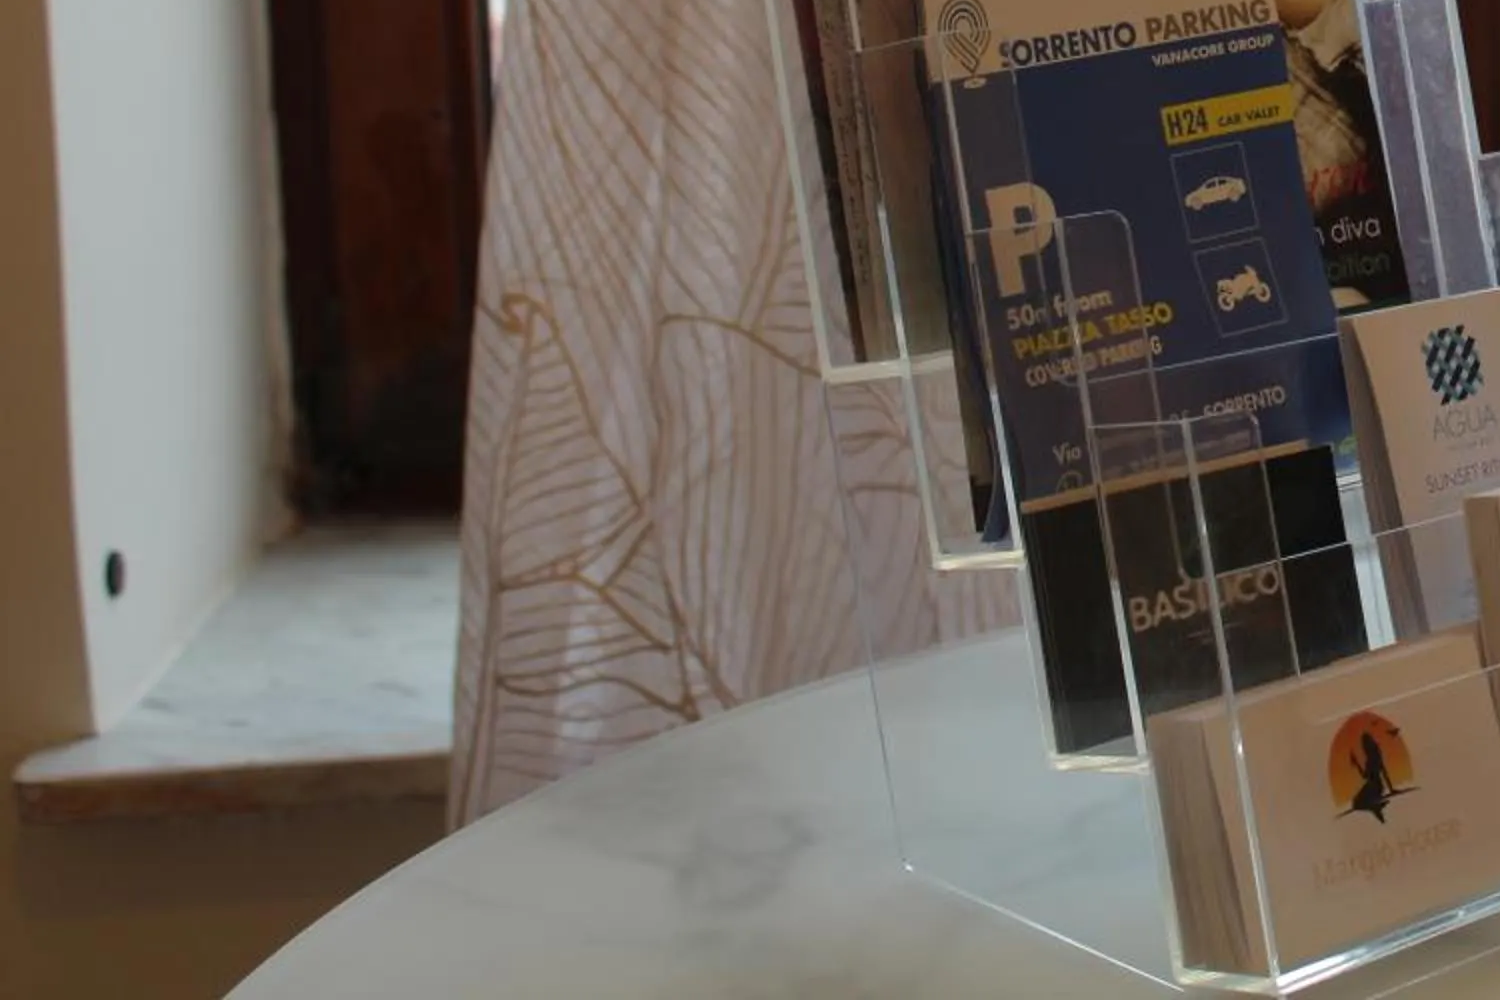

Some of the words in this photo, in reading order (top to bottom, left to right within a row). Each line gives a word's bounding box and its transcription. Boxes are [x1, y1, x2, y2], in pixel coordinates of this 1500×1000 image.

[1000, 21, 1137, 68] SORRENTO
[1151, 43, 1225, 68] VANACORE
[1227, 33, 1275, 55] GROUP
[1166, 107, 1208, 140] H24
[1217, 113, 1242, 129] CAR
[1246, 105, 1281, 122] VALET
[984, 181, 1058, 298] P
[1331, 216, 1382, 244] diva
[1104, 302, 1173, 335] TASSO
[1433, 403, 1499, 442] AGUA
